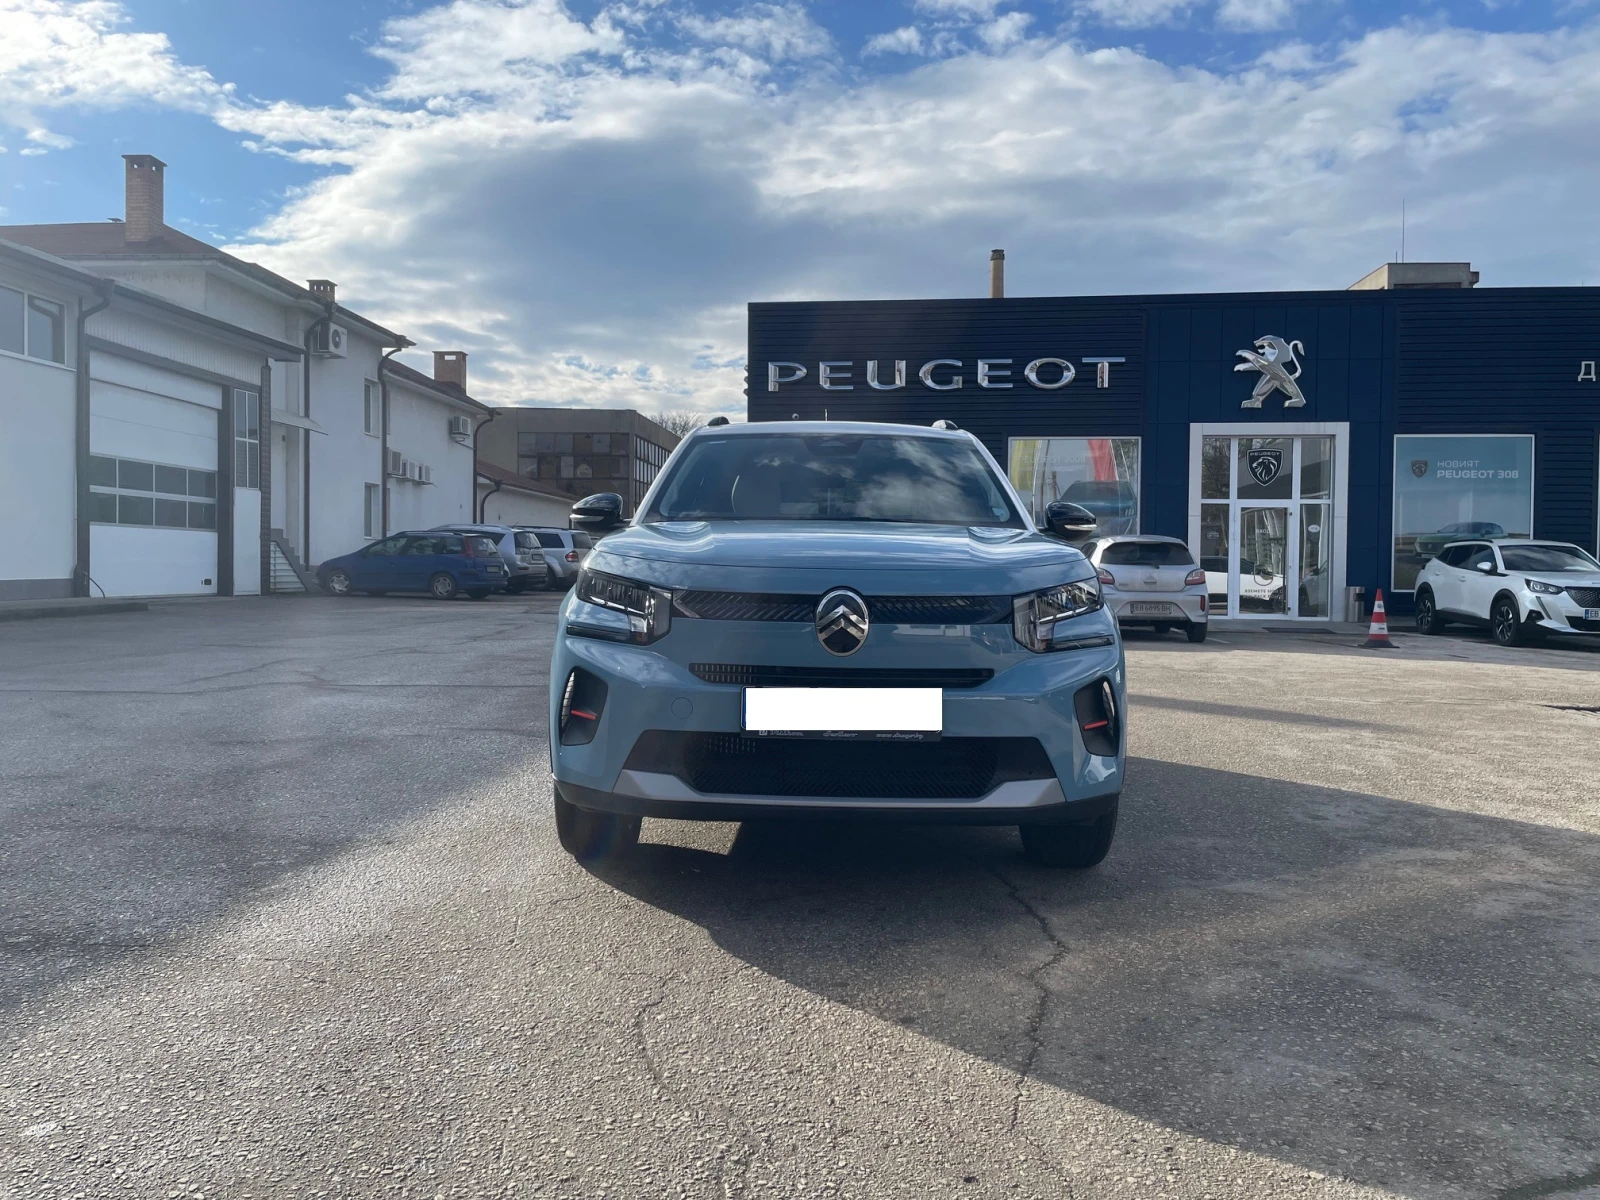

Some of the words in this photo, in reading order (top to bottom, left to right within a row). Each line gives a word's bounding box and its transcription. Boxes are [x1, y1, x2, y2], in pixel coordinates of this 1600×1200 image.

[767, 356, 1127, 392] PEUGEOT
[1436, 460, 1481, 468] НОВИЯТ
[1436, 469, 1495, 479] PEUGEOT
[1497, 469, 1520, 479] 308
